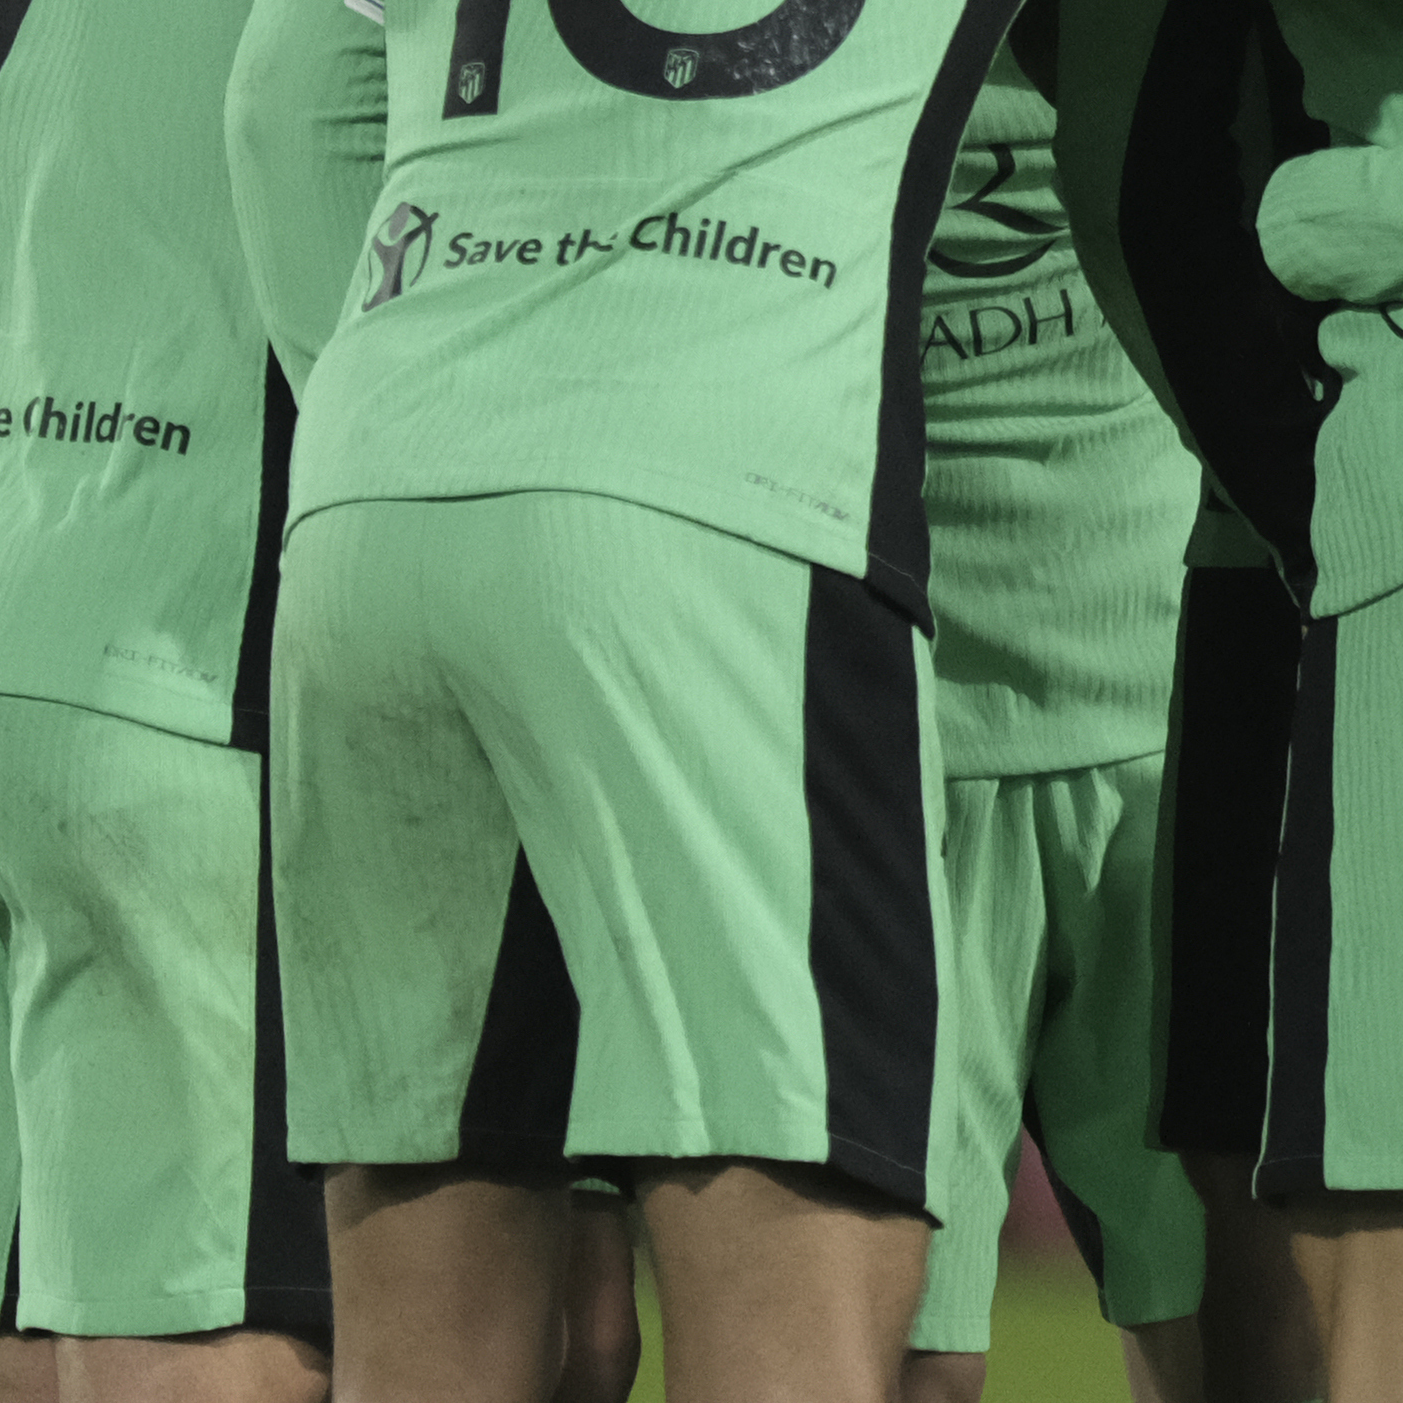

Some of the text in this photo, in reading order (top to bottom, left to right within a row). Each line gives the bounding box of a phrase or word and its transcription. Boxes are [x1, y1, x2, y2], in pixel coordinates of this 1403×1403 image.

[443, 231, 543, 269] Save
[628, 212, 838, 289] Children
[23, 396, 191, 456] Children
